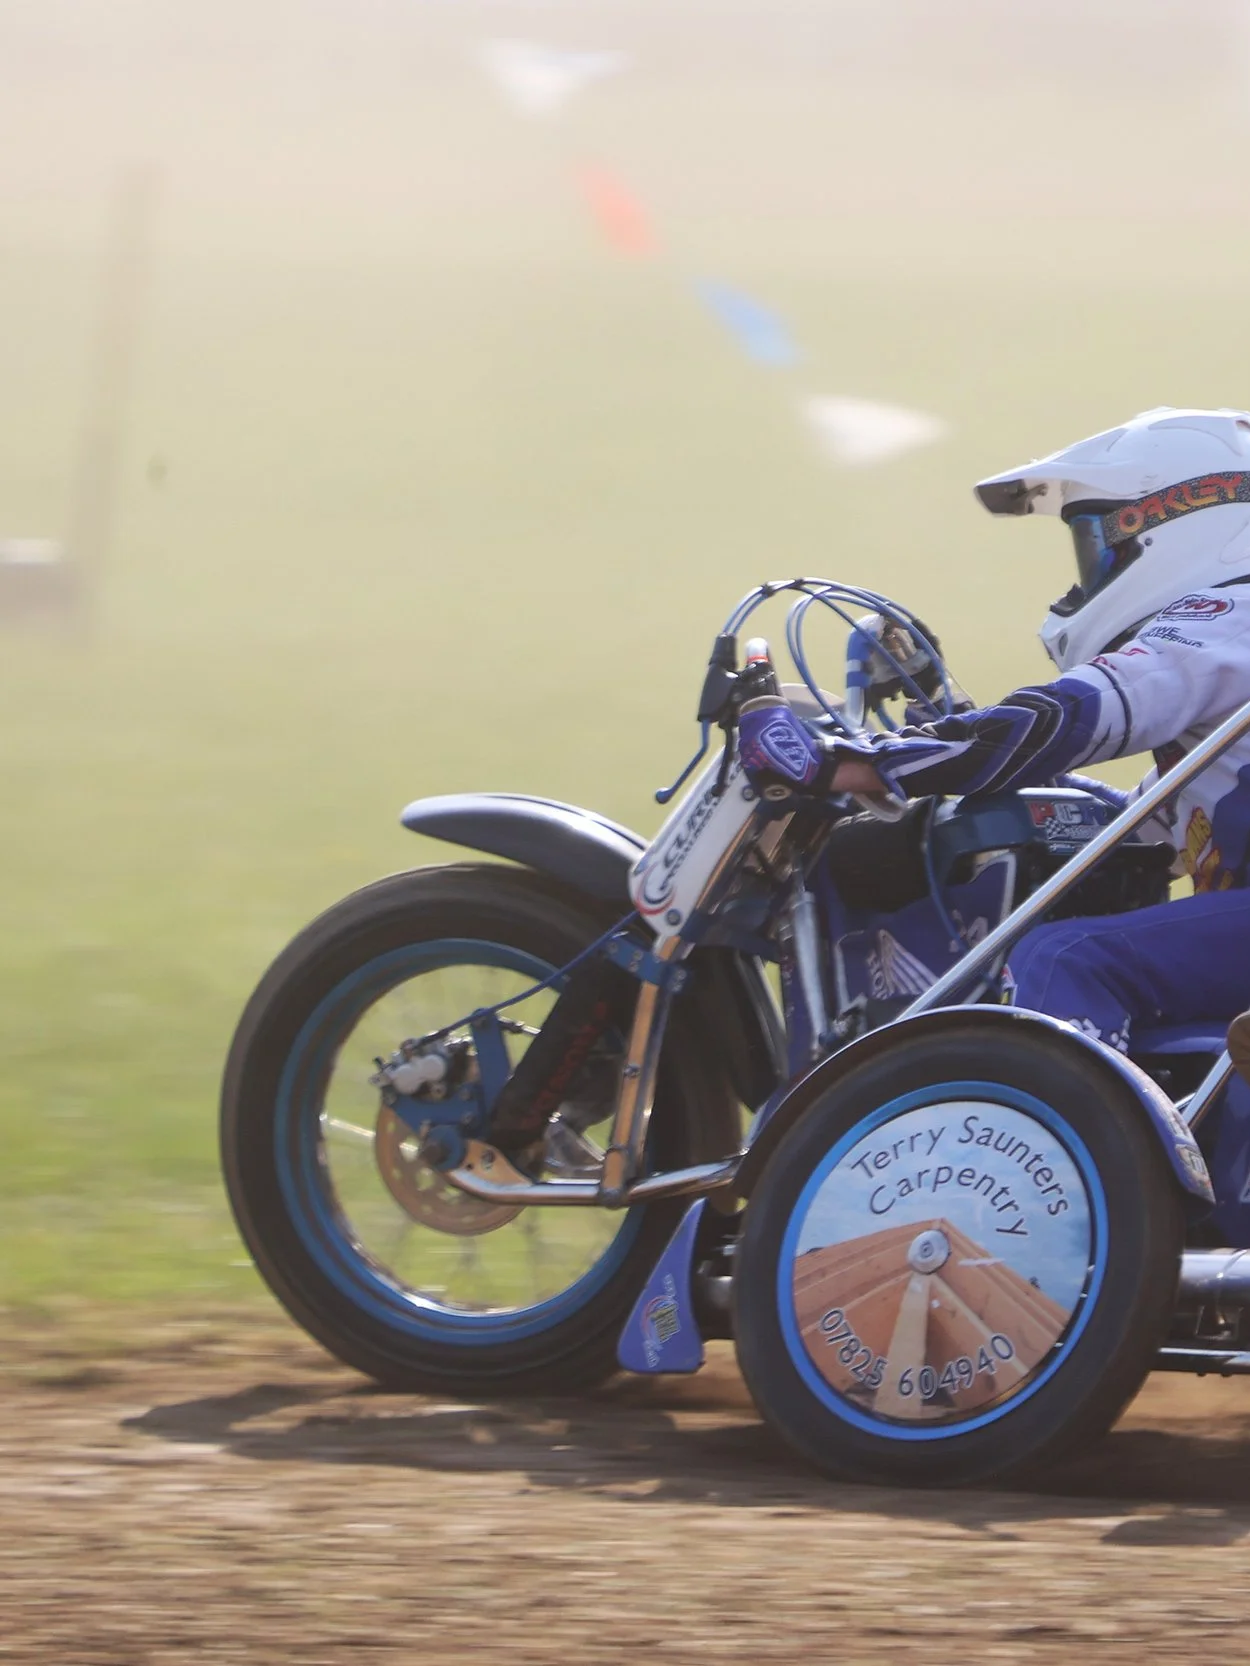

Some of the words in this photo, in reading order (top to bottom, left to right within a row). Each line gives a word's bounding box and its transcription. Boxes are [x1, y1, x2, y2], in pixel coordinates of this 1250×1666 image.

[1118, 473, 1243, 534] OAKLEY
[851, 1124, 947, 1180] Terry
[958, 1116, 1069, 1217] Saunters
[869, 1165, 1029, 1238] Carpentry
[819, 1308, 888, 1389] 07825
[899, 1334, 1015, 1399] 604940
